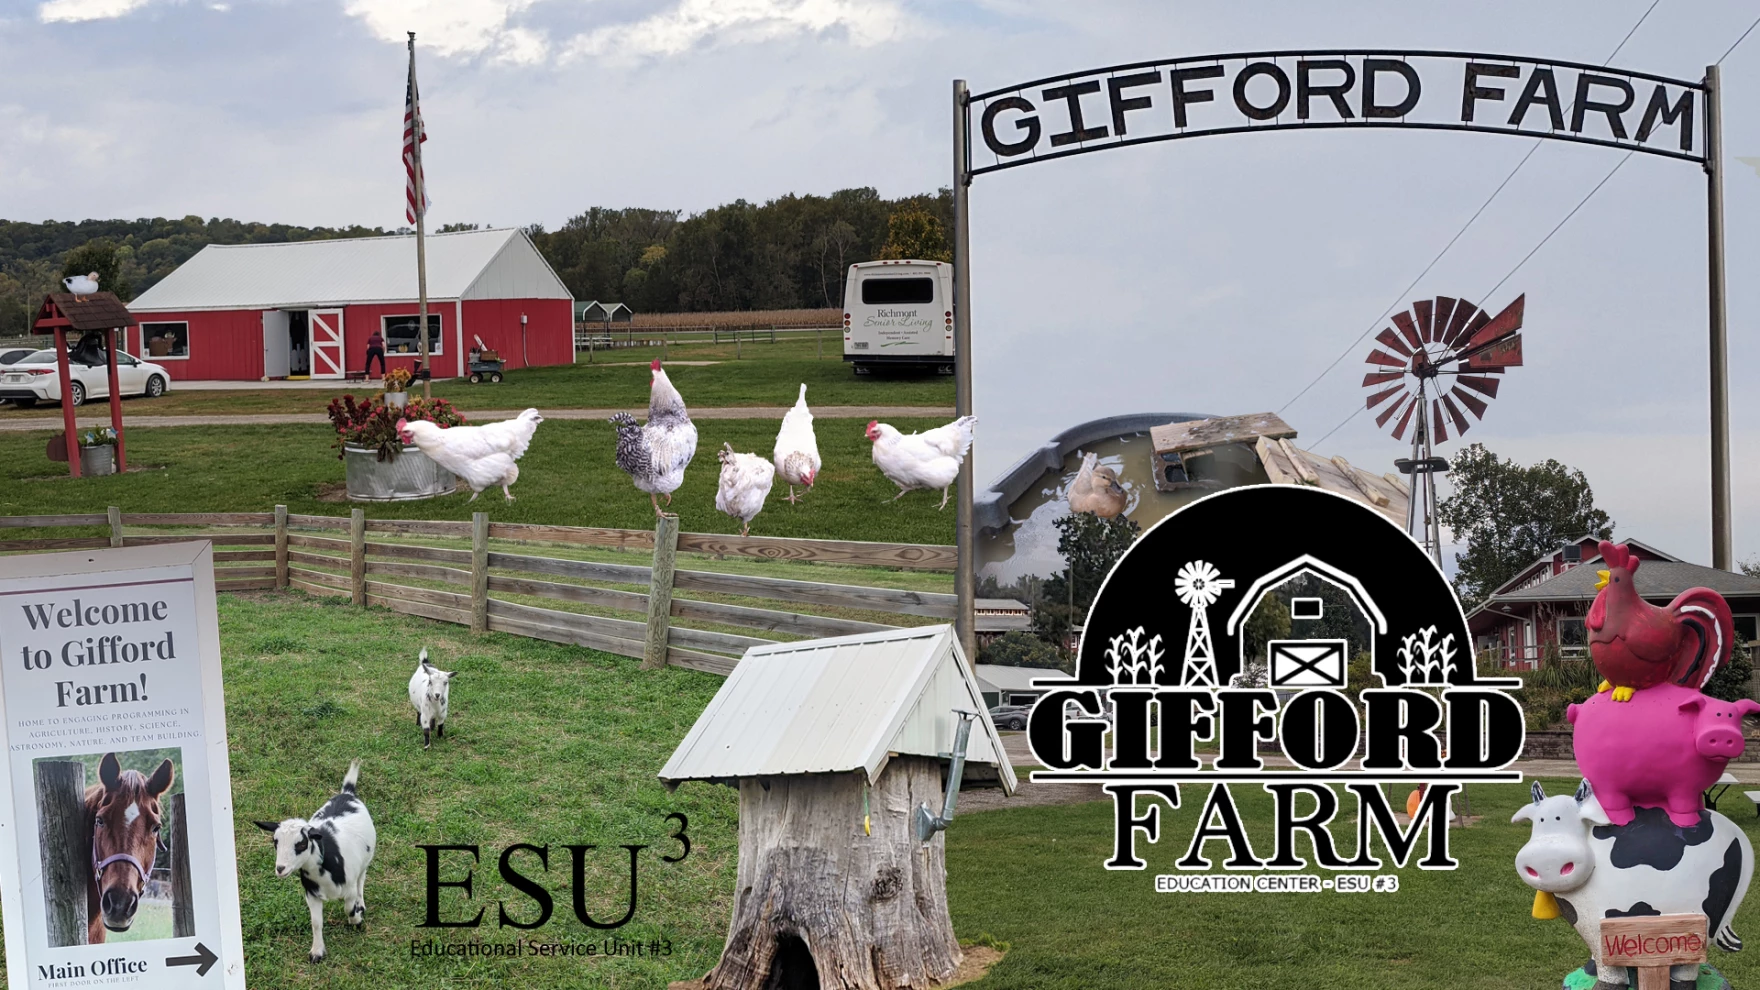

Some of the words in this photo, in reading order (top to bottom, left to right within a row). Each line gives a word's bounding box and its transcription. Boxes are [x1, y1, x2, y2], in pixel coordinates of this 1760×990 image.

[981, 58, 1422, 157] GIFFORD
[1460, 60, 1695, 151] FARM
[863, 315, 896, 327] Senior
[897, 315, 933, 332] Living
[877, 309, 918, 317] Richmont
[21, 599, 168, 630] Welcome
[20, 646, 52, 671] to
[61, 631, 176, 667] Gifford
[55, 673, 148, 708] Farm!
[18, 719, 45, 728] HOME
[62, 714, 109, 724] ENGAGING
[111, 708, 177, 720] PROGRAMMING
[180, 707, 189, 715] IN
[9, 741, 67, 752] ASTRONOMY,
[110, 736, 128, 744] AND
[130, 734, 154, 743] TEAM
[157, 730, 202, 741] BUILDING.
[1605, 934, 1700, 957] Welcome
[38, 961, 85, 980] Main
[91, 957, 148, 977] Office
[70, 979, 91, 987] DOOR
[122, 975, 139, 983] LEFT
